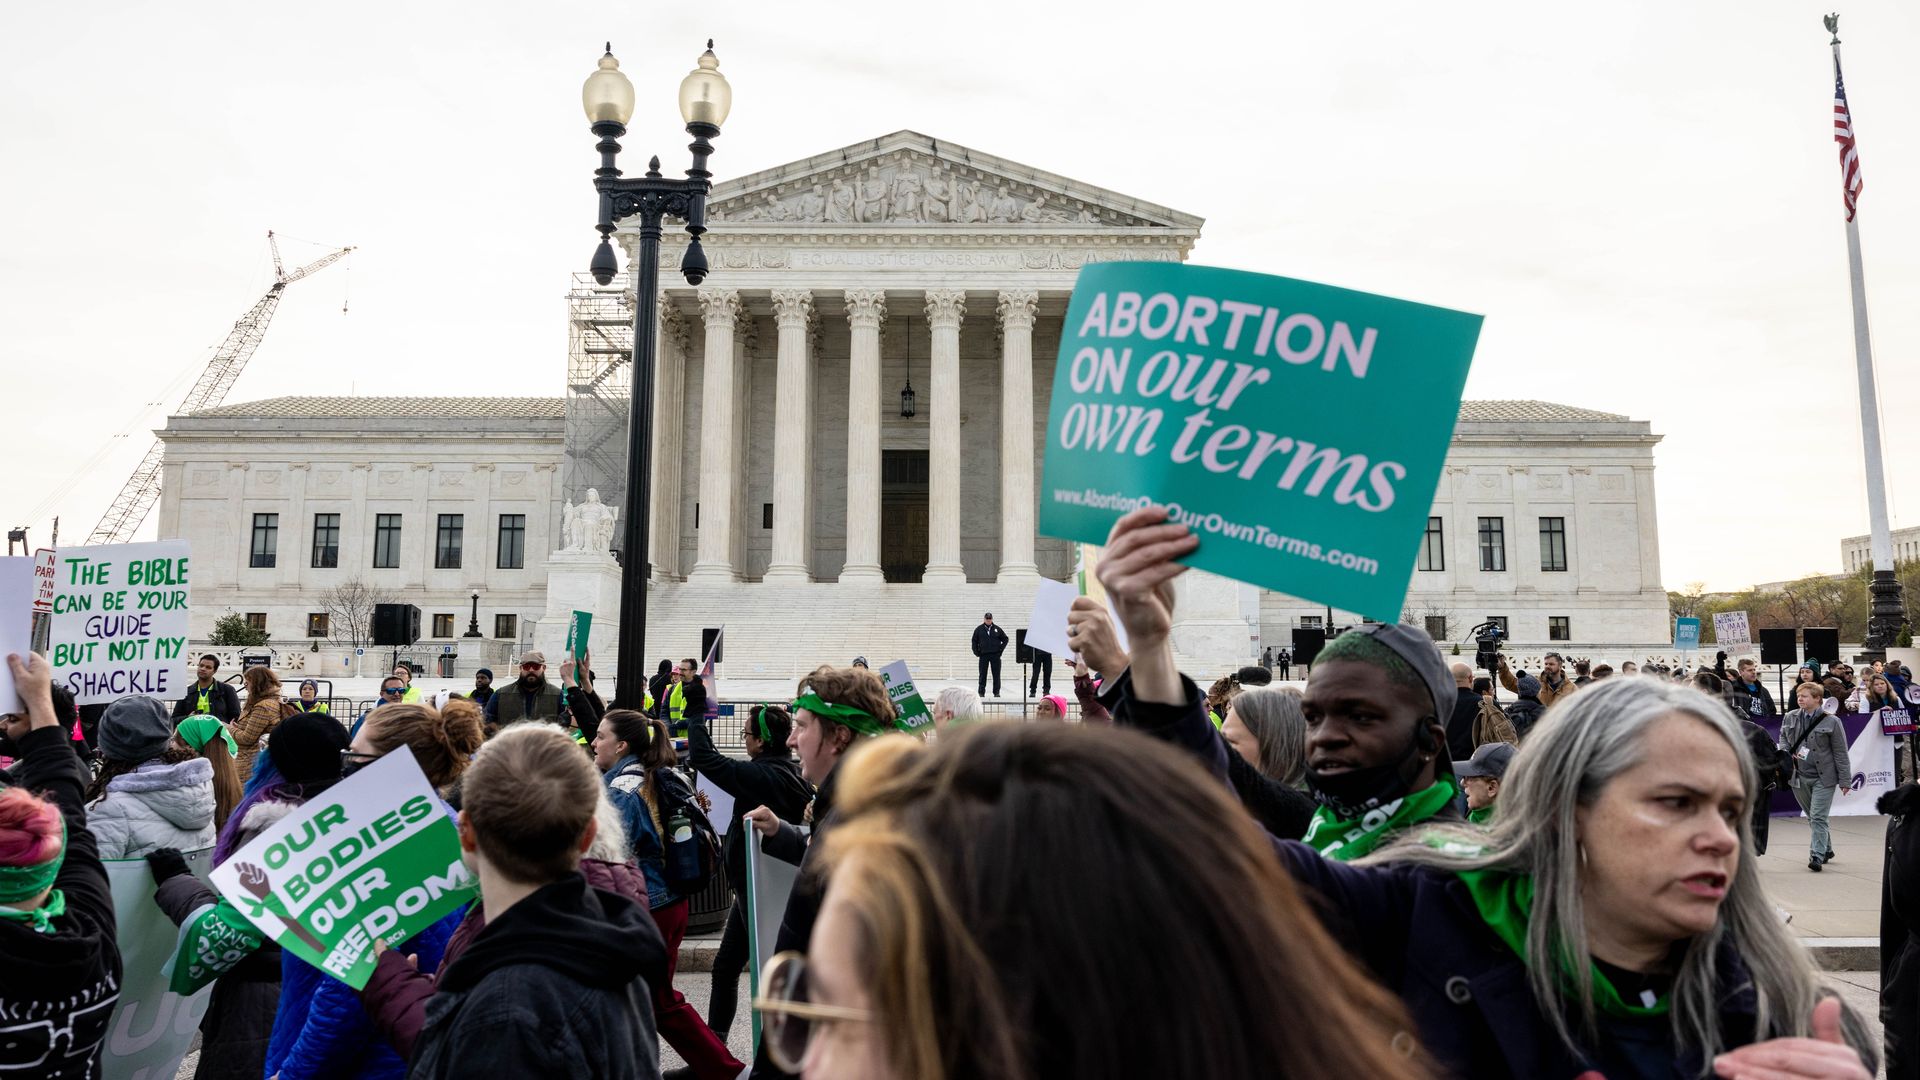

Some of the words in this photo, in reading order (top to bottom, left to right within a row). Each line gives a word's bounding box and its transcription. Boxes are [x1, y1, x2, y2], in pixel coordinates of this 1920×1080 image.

[802, 253, 853, 266] EQUAL
[860, 253, 916, 266] JUSTICE
[923, 253, 974, 266] UNDER
[980, 253, 1009, 266] LAW
[1078, 291, 1378, 378] ABORTION
[1070, 347, 1132, 394] ON
[1137, 350, 1271, 411] our
[1060, 402, 1163, 456] own
[1171, 407, 1406, 513] terms
[47, 555, 55, 565] N
[65, 558, 112, 585] THE
[128, 558, 189, 586] BIBLE
[39, 589, 53, 599] TIM
[42, 580, 54, 589] AN
[53, 594, 92, 614] CAN
[102, 591, 128, 611] BE
[137, 590, 189, 611] YOUR
[85, 614, 152, 639] GUIDE
[1716, 622, 1747, 631] HUMAN
[1717, 629, 1746, 640] LIFE
[53, 641, 99, 667] BUT
[108, 639, 149, 662] NOT
[154, 636, 186, 660] MY
[66, 669, 169, 696] SHACKLE
[888, 681, 914, 698] DIES
[1882, 709, 1910, 719] CHEMICAL
[1884, 717, 1912, 727] ABORTION
[263, 803, 350, 870] OUR
[282, 795, 433, 904] BODIES
[309, 866, 392, 935] OUR
[321, 859, 471, 978] FREEDOM
[384, 928, 407, 946] ARCH
